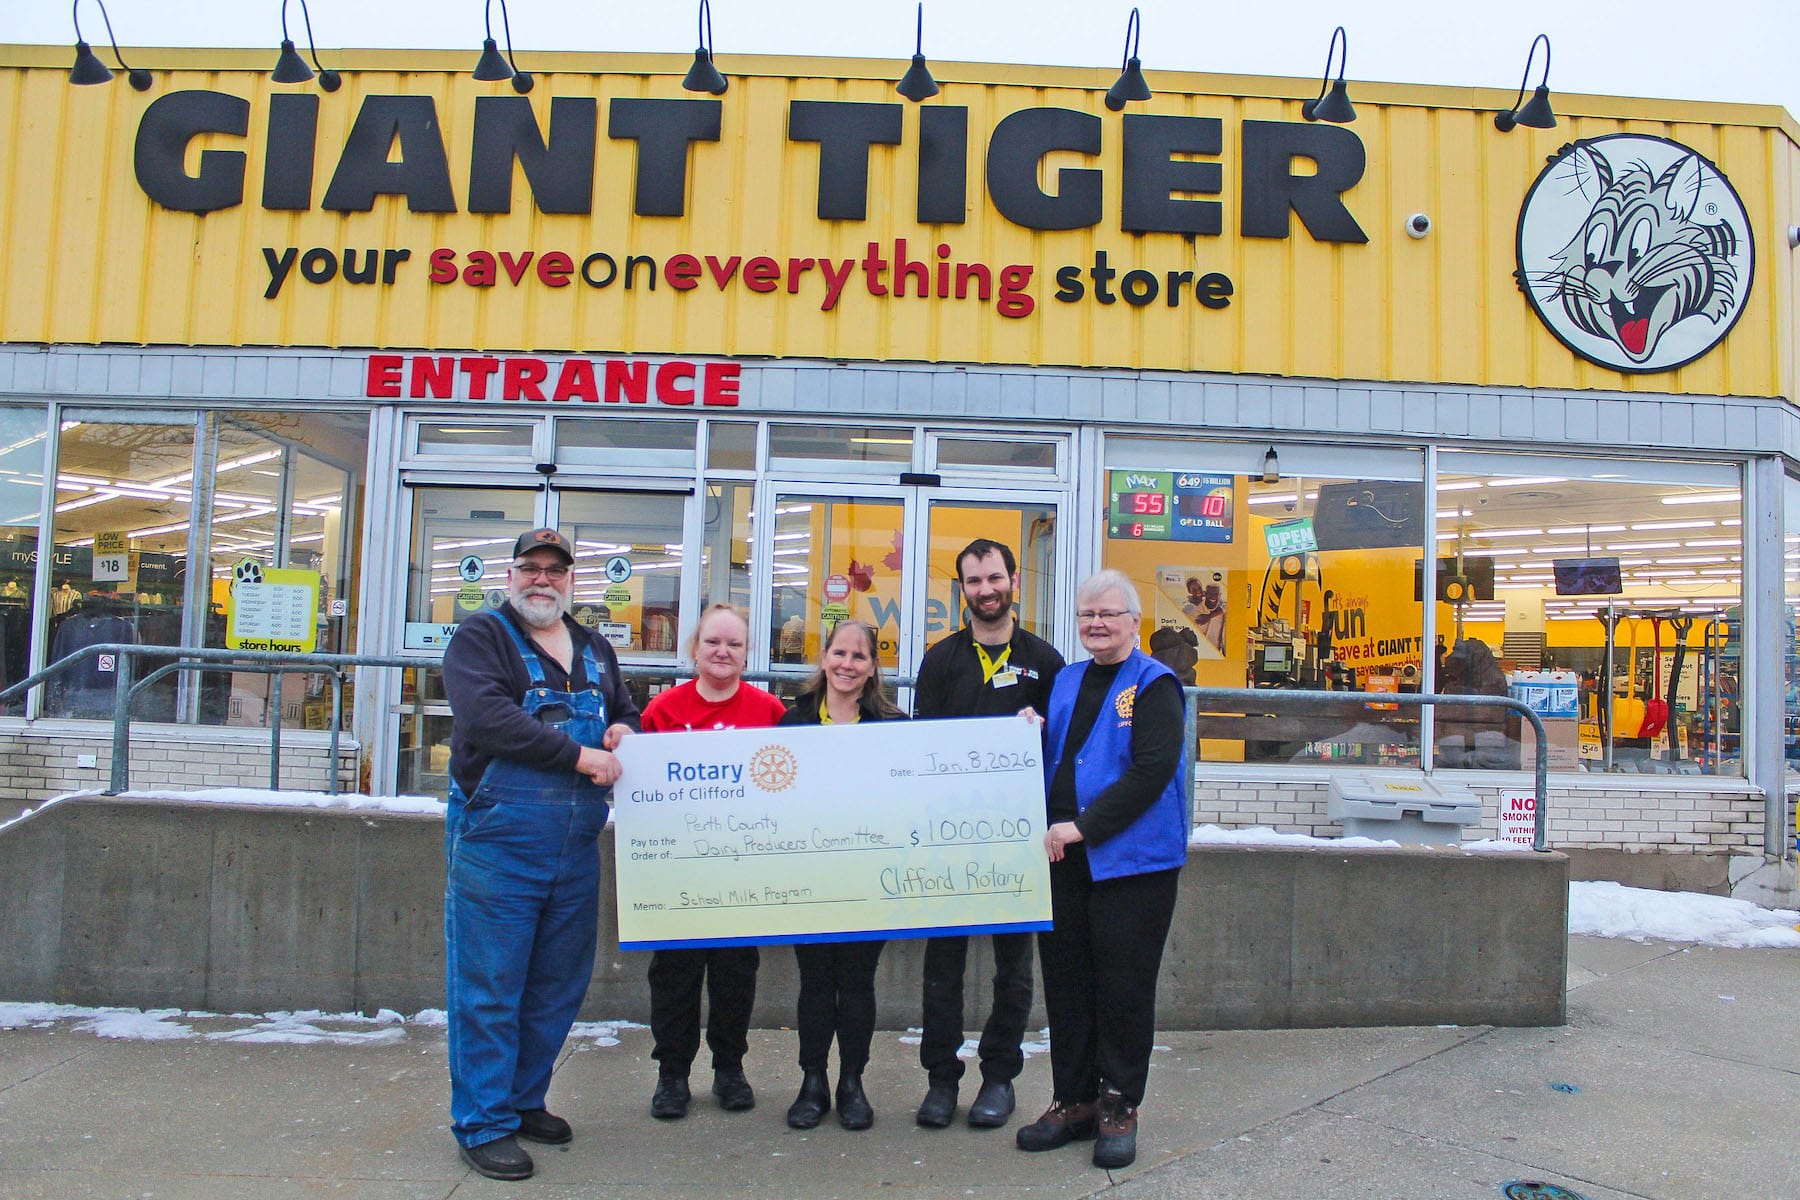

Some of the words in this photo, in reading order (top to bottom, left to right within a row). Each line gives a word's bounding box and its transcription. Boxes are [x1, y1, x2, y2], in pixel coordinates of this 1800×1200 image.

[133, 89, 723, 218] GIANT
[788, 99, 1371, 244] TIGER
[262, 246, 412, 300] your
[428, 237, 1036, 319] saveoneverything
[1055, 250, 1234, 309] store
[366, 354, 742, 407] ENTRANCE
[1134, 494, 1163, 513] 55
[1202, 497, 1223, 516] 10
[98, 533, 118, 541] LOW
[1133, 524, 1142, 537] 6
[1267, 527, 1313, 548] OPEN
[98, 541, 124, 549] PRICE
[239, 639, 267, 651] store
[270, 639, 301, 653] hours
[1334, 644, 1360, 661] save
[1363, 638, 1375, 658] at
[1377, 637, 1412, 657] GIANT
[667, 761, 743, 783] Rotary
[890, 768, 914, 777] Date:
[631, 791, 664, 803] Club
[668, 788, 685, 801] of
[689, 786, 745, 800] Clifford
[1511, 798, 1537, 811] NO
[684, 813, 722, 833] Perth
[727, 813, 778, 834] County
[1502, 812, 1536, 821] SMOKIN
[910, 829, 920, 848] $
[928, 818, 1032, 842] 1000.00
[631, 839, 647, 848] Pay
[661, 837, 677, 846] the
[744, 835, 807, 854] Producers
[812, 826, 889, 849] Committee
[1512, 836, 1532, 844] FEET
[631, 852, 657, 861] Order
[660, 851, 673, 860] of:
[880, 865, 955, 896] Clifford
[966, 861, 1025, 898] Rotary
[680, 892, 723, 906] School
[729, 889, 759, 904] Milk
[764, 886, 813, 904] Program
[633, 902, 666, 911] Memo:
